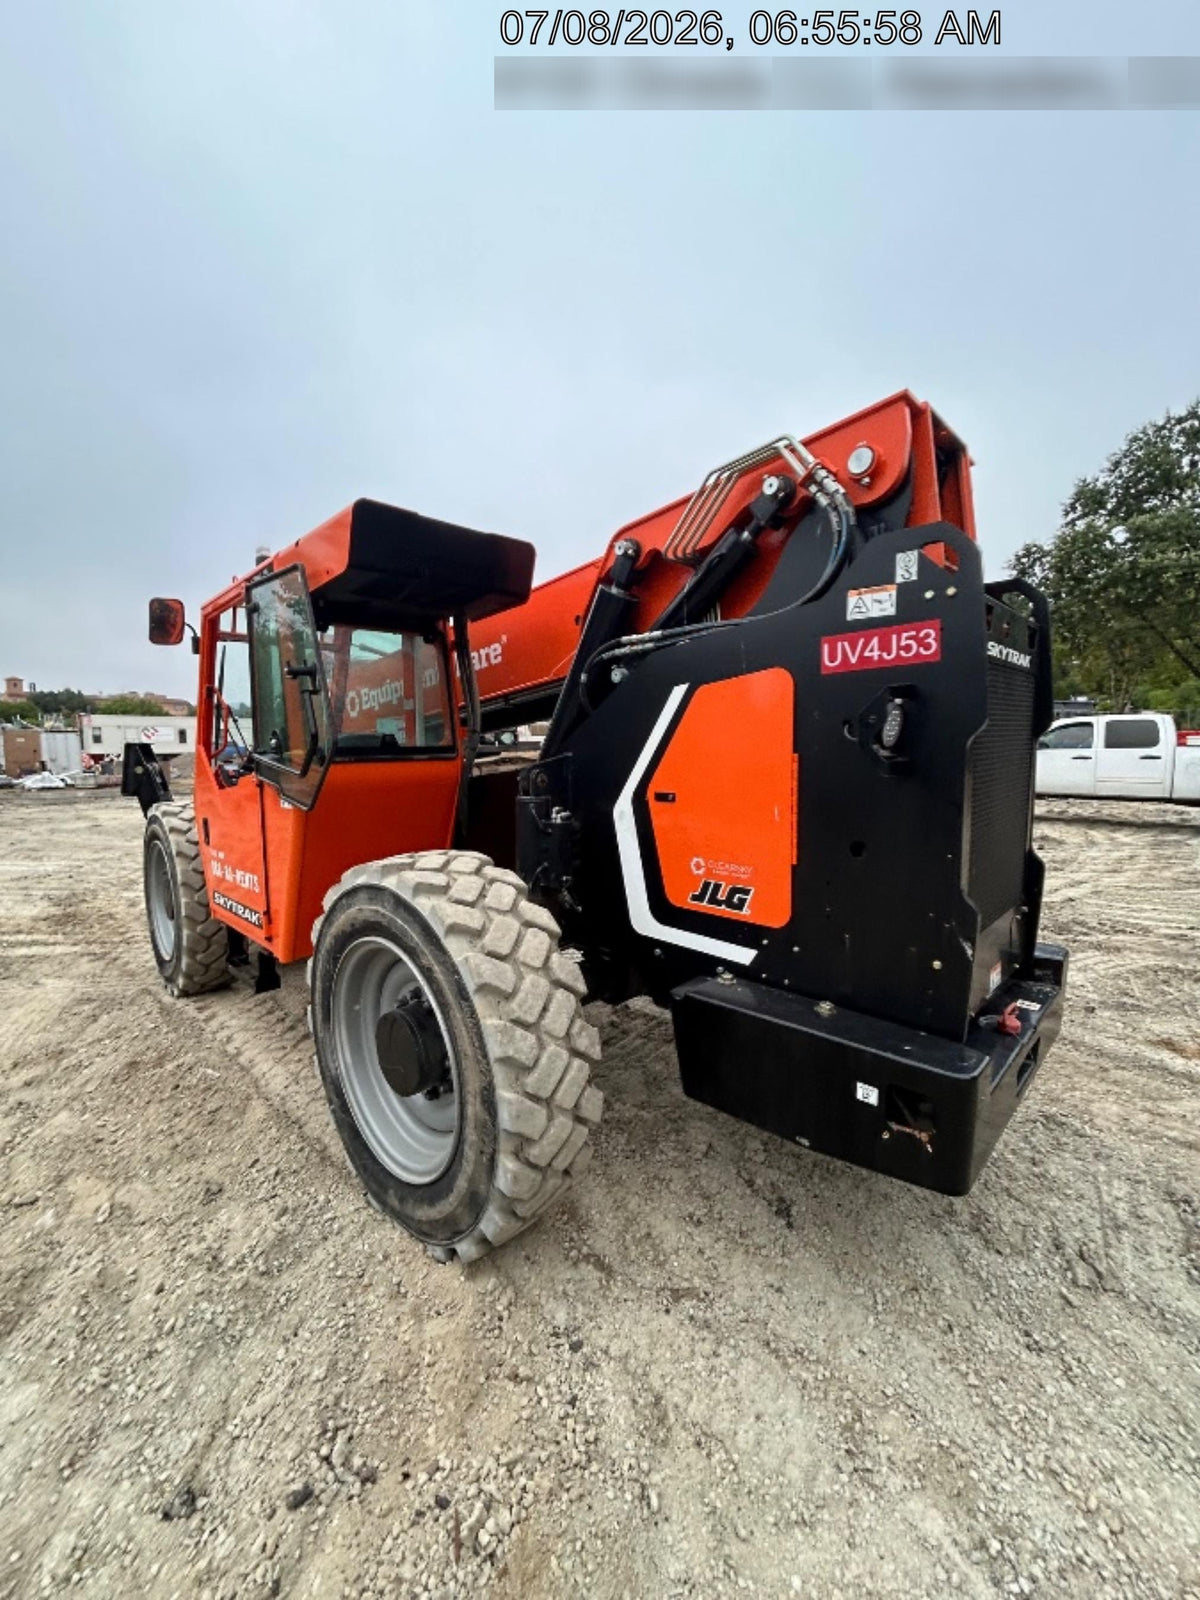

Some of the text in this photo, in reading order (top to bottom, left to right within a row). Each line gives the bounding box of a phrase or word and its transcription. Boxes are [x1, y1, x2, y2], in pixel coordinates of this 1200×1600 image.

[823, 628, 937, 667] UV4J53
[986, 641, 1032, 669] SKYTRAK
[214, 892, 261, 925] SKYTRAK
[689, 879, 754, 914] JLG
